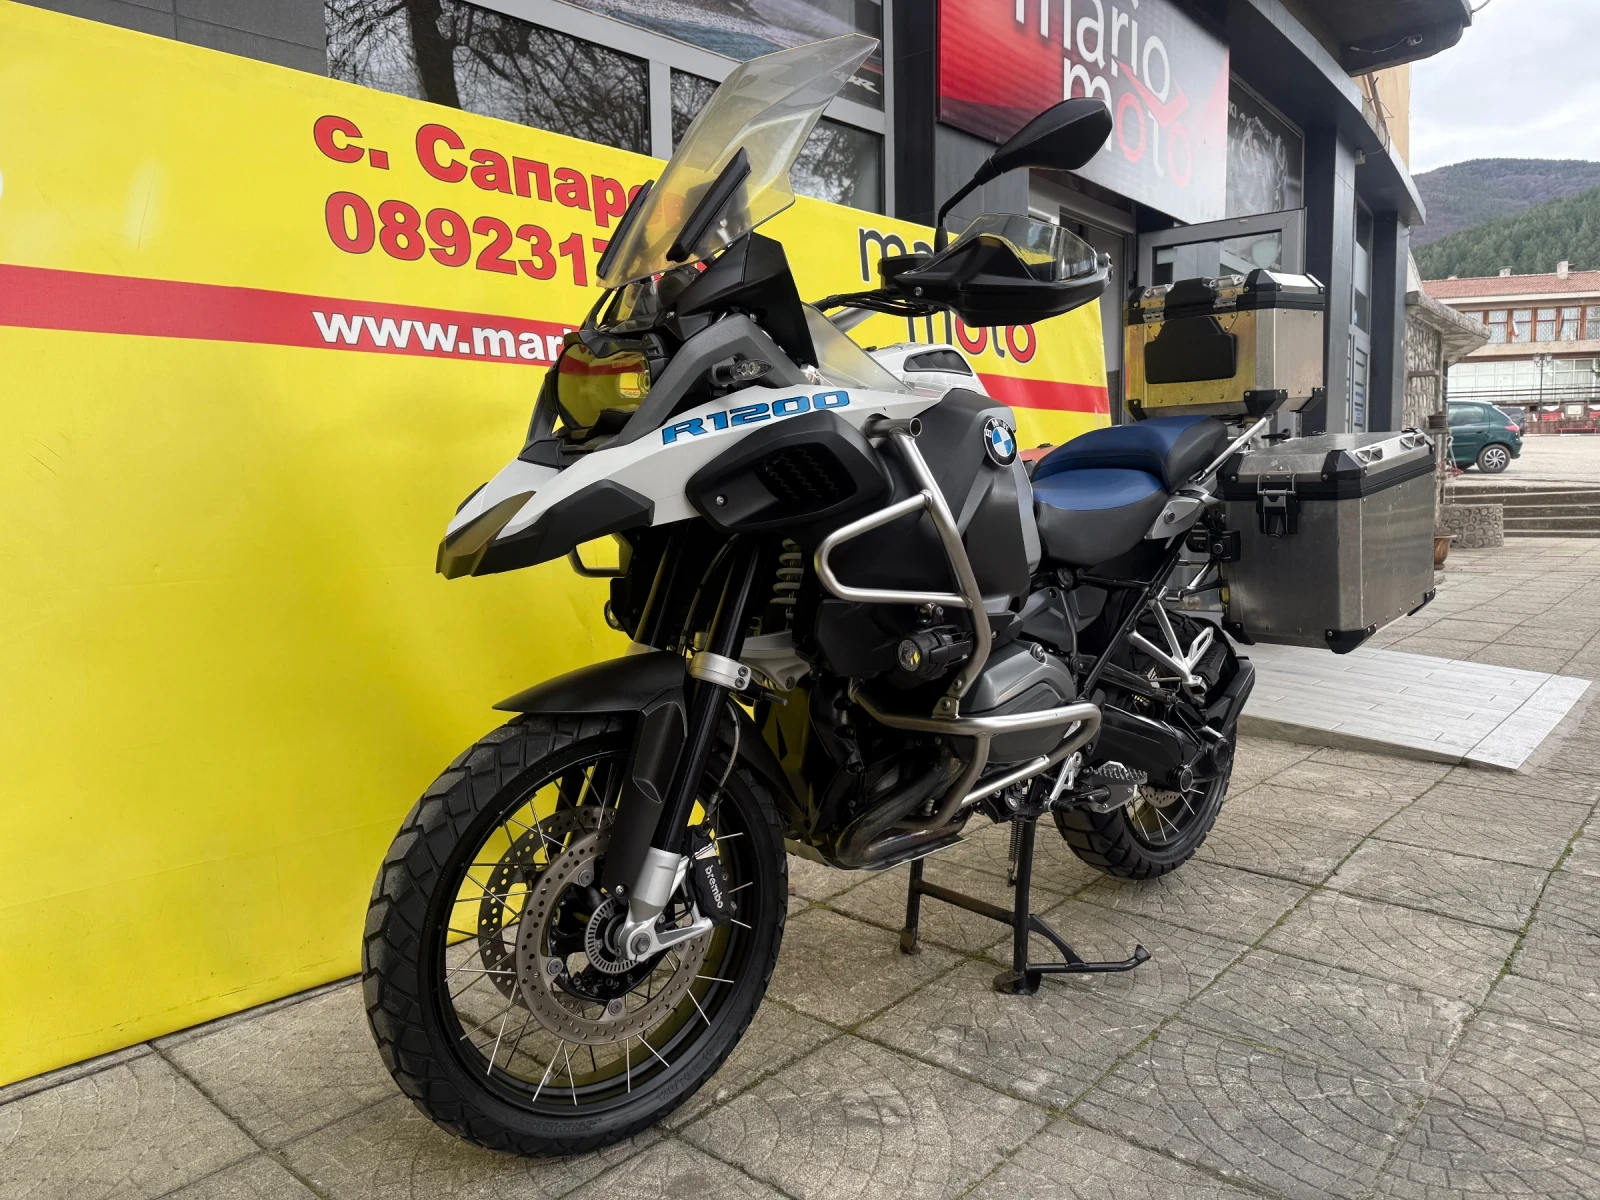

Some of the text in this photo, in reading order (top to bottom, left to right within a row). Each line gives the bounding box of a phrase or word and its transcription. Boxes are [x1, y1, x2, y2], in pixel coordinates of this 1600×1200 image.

[313, 115, 390, 170] с.
[325, 191, 611, 288] 089231
[311, 310, 573, 362] www.mar
[661, 390, 851, 446] R1200
[704, 864, 724, 909] brembo
